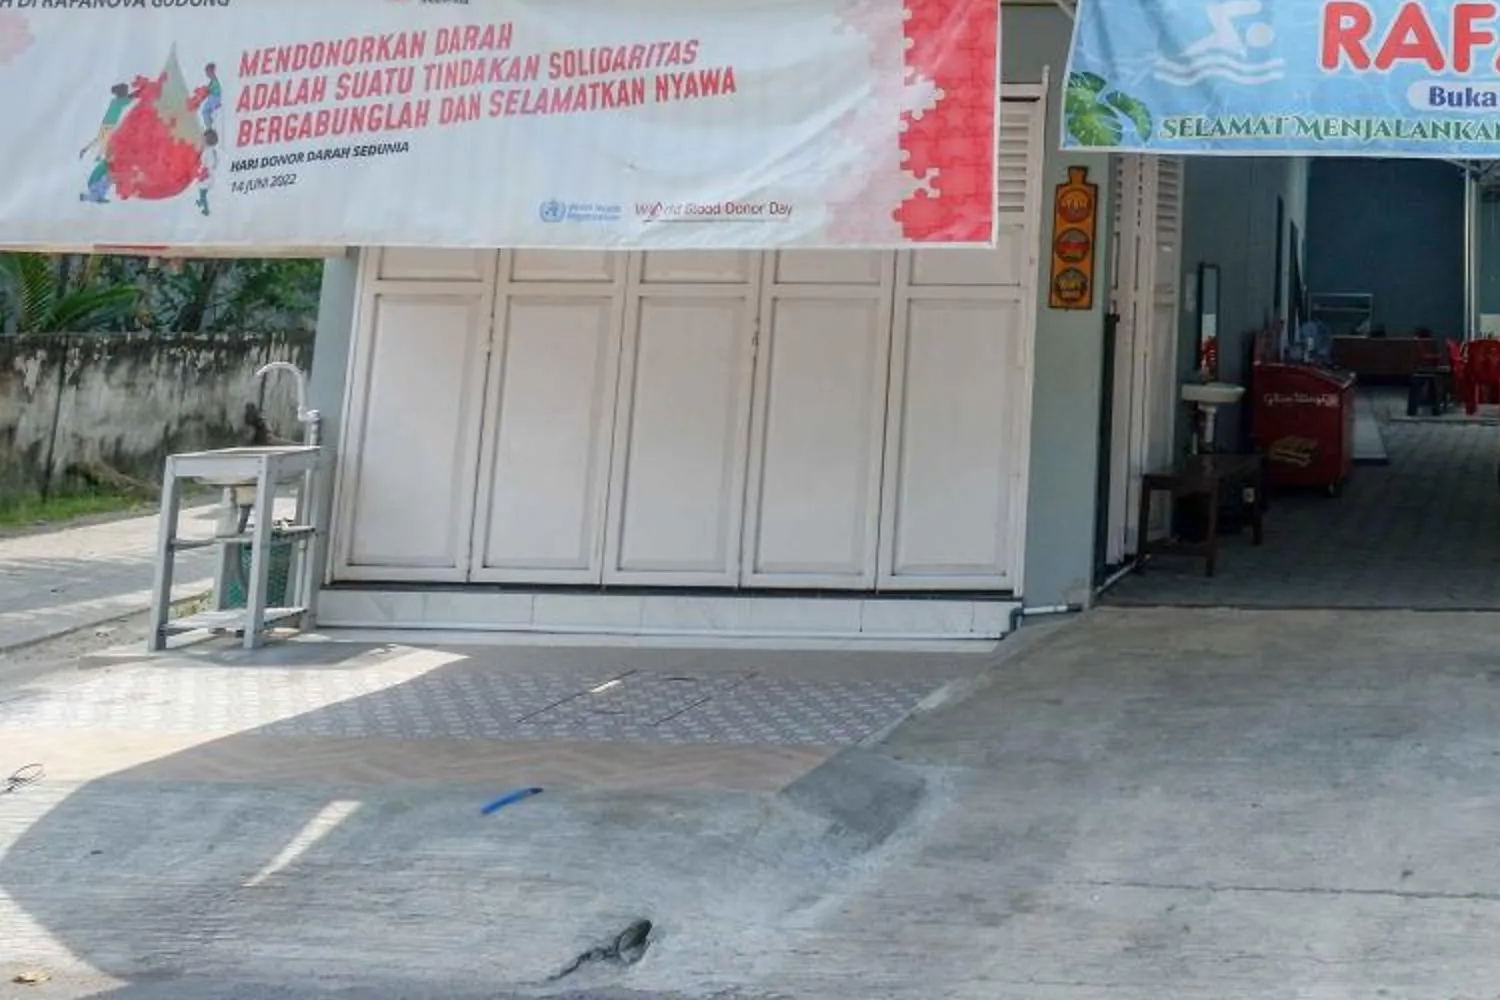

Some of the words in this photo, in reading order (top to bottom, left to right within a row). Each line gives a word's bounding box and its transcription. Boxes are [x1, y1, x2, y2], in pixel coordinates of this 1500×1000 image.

[238, 31, 427, 78] MENDONORKAN
[434, 22, 513, 57] DARAH
[235, 75, 327, 113] ADALAH
[334, 66, 415, 101] SUATU
[423, 55, 541, 92] TINDAKAN
[548, 39, 700, 79] SOLIDARITAS
[236, 99, 430, 148] BERGABUNGLAH
[439, 92, 481, 126] DAN
[489, 77, 646, 118] SELAMATKAN
[655, 66, 737, 103] NYAWA
[1428, 86, 1497, 108] Buka
[1160, 115, 1288, 140] SELAMAT
[231, 159, 258, 173] HARI
[261, 152, 305, 169] DONOR
[307, 147, 350, 163] DARAH
[352, 141, 409, 158] SEDUNIA
[725, 202, 764, 215] Donor
[769, 201, 793, 216] Day
